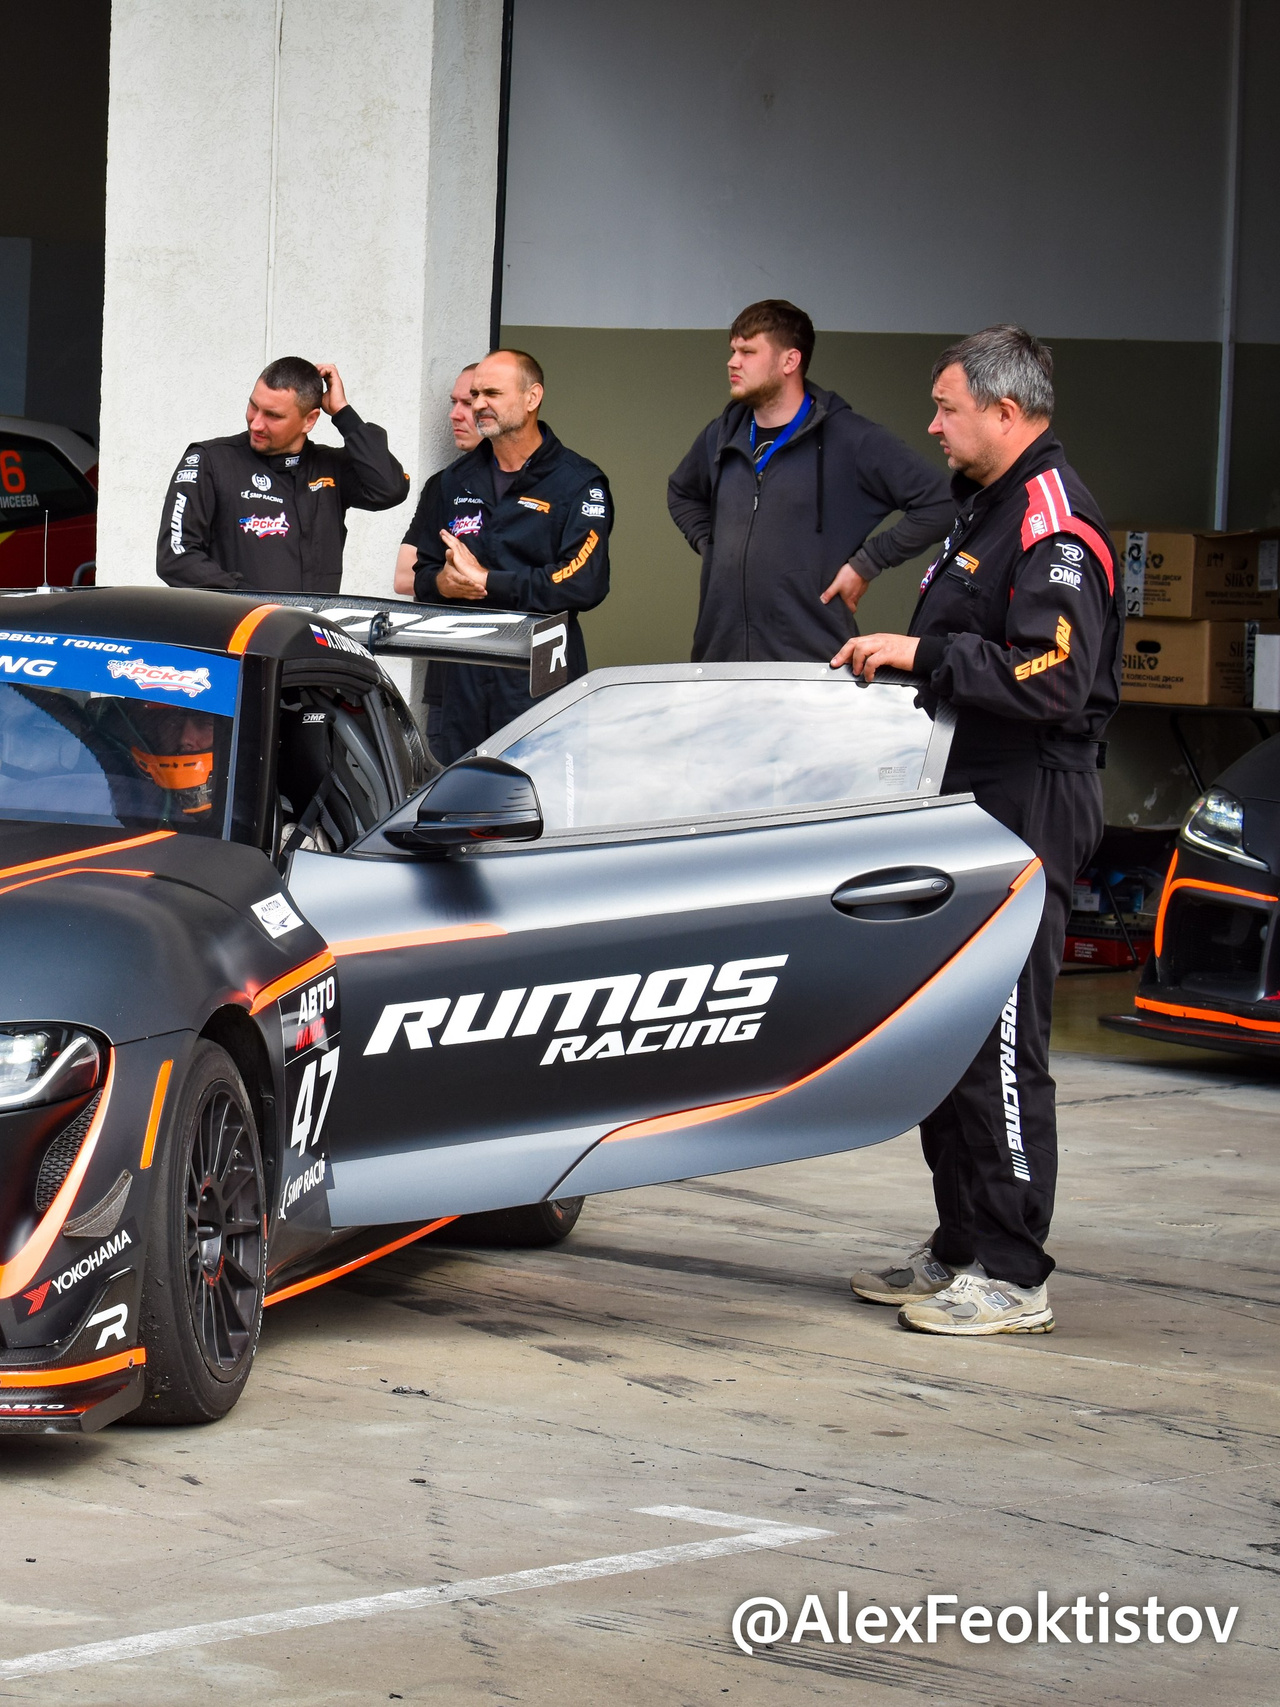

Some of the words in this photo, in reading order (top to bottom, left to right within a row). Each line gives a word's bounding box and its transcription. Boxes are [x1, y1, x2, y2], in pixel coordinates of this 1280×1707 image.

[176, 470, 198, 482] OMP
[249, 491, 263, 499] SMP
[263, 494, 283, 504] RACING
[581, 504, 605, 516] OMP
[170, 491, 187, 555] RUMOS
[252, 520, 281, 529] РСКГ
[1030, 513, 1045, 535] OMP
[551, 529, 599, 583] RUMOS
[1049, 567, 1081, 586] OMP
[62, 637, 133, 655] гонок
[533, 623, 568, 673] R
[131, 667, 193, 683] РСКГ
[302, 713, 326, 723] OMP
[298, 975, 335, 1027] АВТО
[362, 954, 790, 1056] RUMOS
[539, 1011, 767, 1066] RACING
[290, 1045, 340, 1158] 47
[999, 1042, 1024, 1153] RACING
[286, 1173, 303, 1208] SMP
[51, 1229, 133, 1295] YOKOHAMA
[85, 1303, 128, 1351] R
